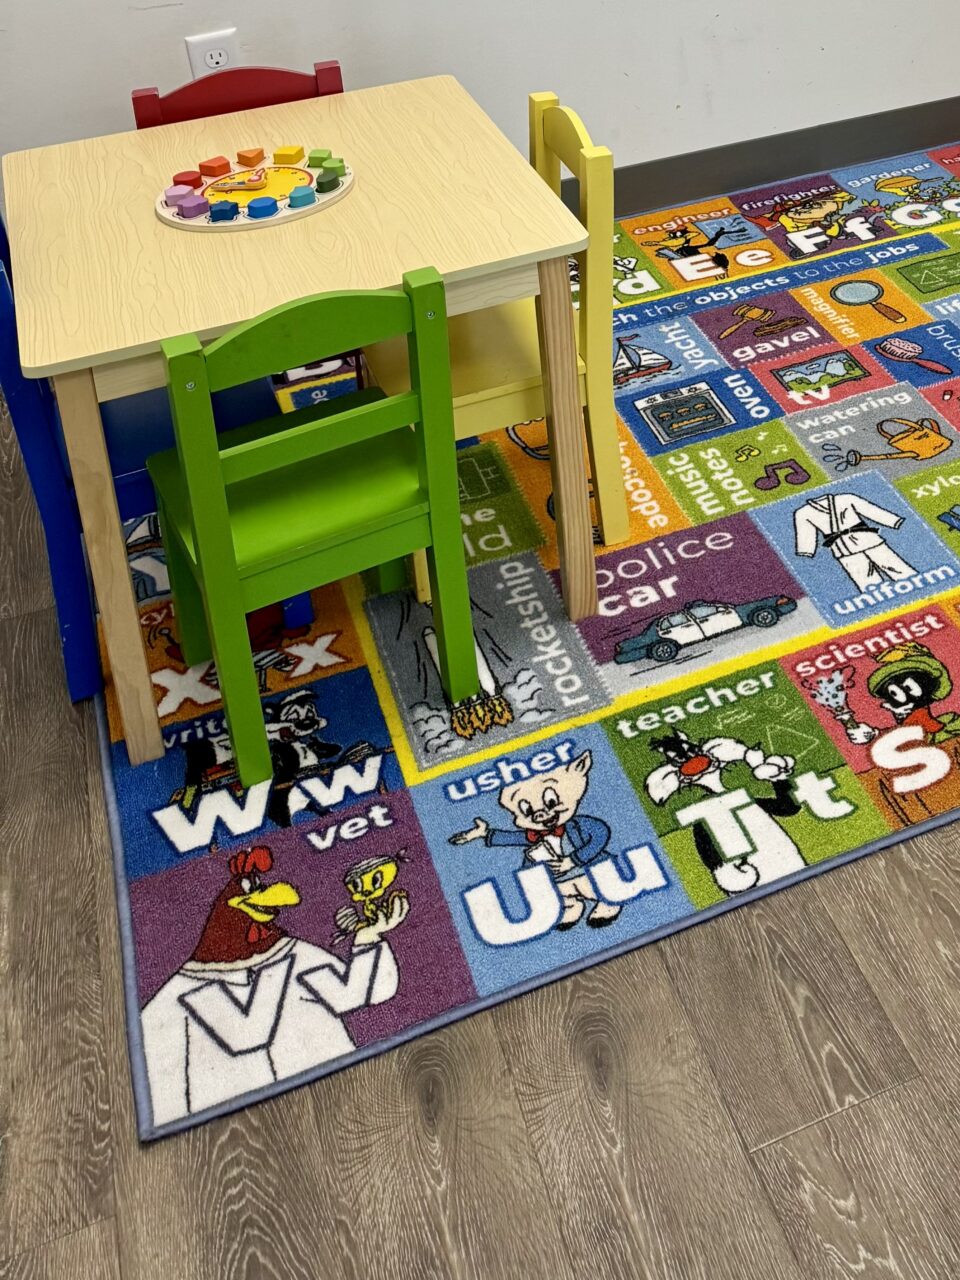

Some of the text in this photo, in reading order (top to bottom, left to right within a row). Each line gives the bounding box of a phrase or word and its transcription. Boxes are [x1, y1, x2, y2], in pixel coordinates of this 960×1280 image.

[742, 185, 837, 210] firefighter
[847, 161, 932, 188] gardener
[632, 207, 732, 235] engineer
[643, 242, 921, 317] the objects to the jobs
[801, 287, 861, 340] magnifier
[659, 322, 718, 370] yacht
[732, 326, 821, 362] gavel
[723, 373, 771, 420] oven
[787, 385, 831, 405] tv
[796, 389, 912, 430] watering
[807, 423, 857, 444] can
[666, 452, 725, 517] music
[699, 448, 755, 506] notes
[598, 574, 679, 617] car
[832, 562, 956, 616] uniform
[495, 561, 590, 710] rocketship
[796, 612, 944, 677] scientist
[616, 670, 775, 739] teacher
[447, 740, 574, 801] usher
[307, 802, 393, 851] vet
